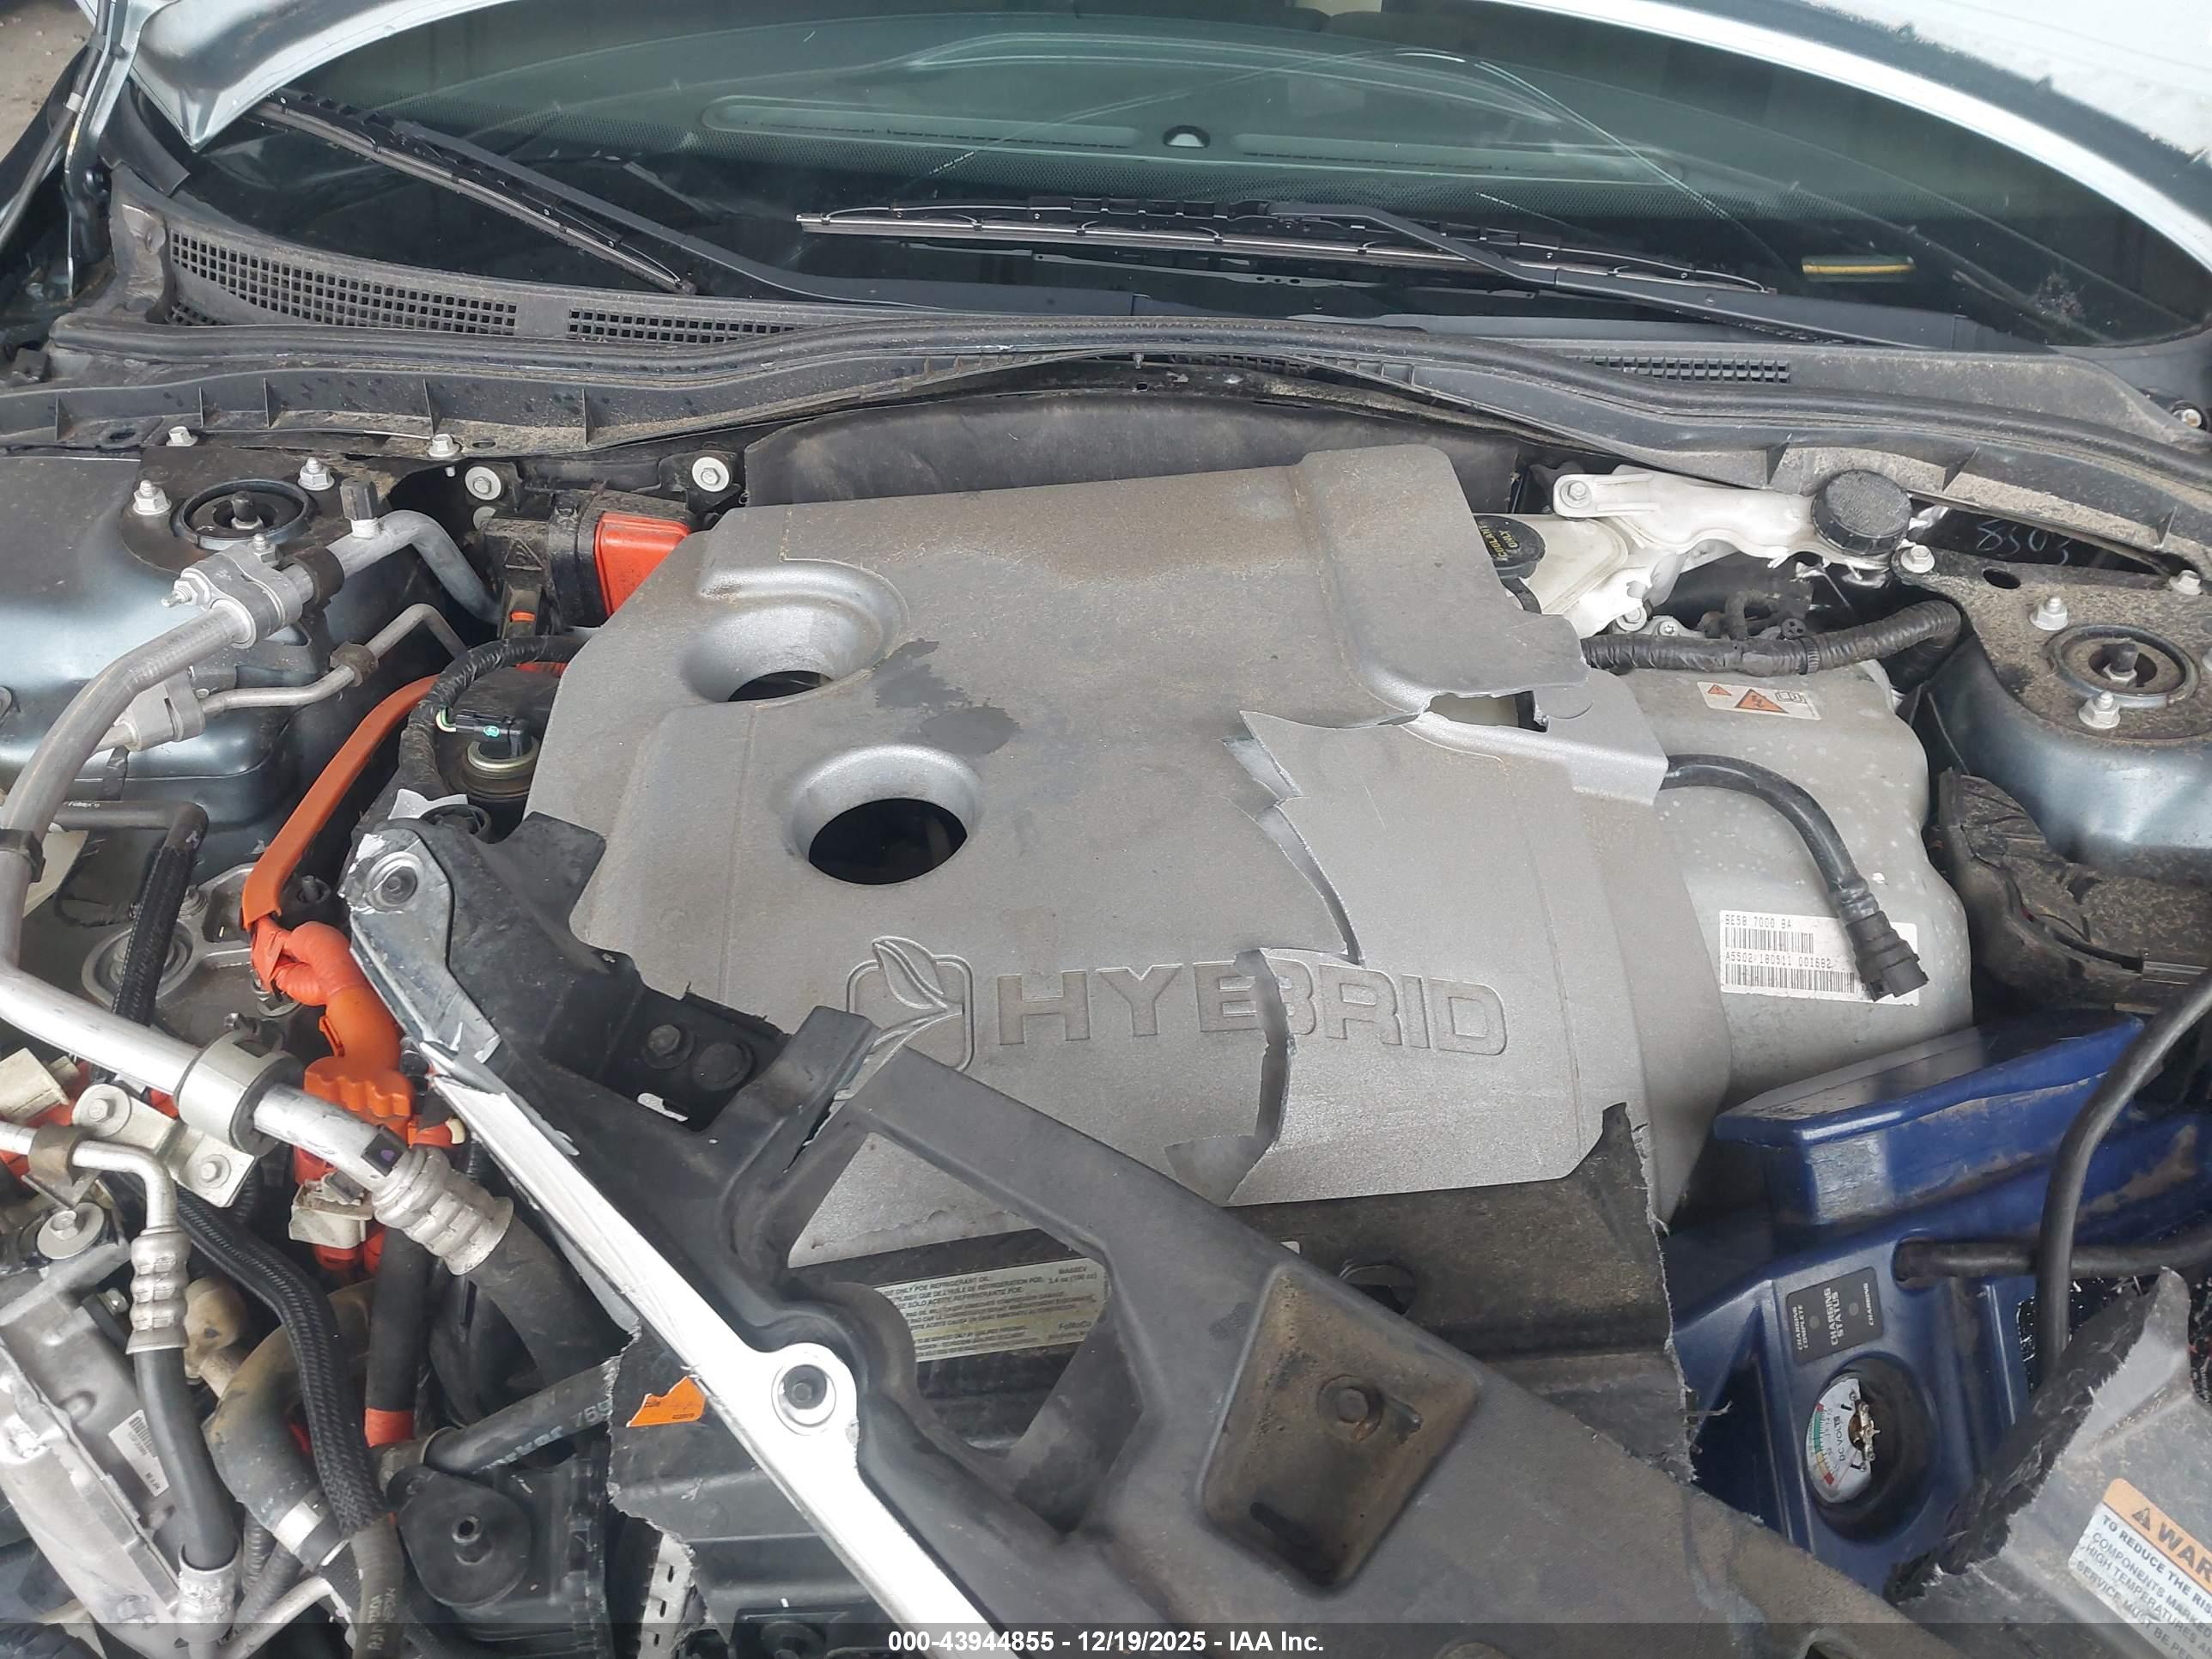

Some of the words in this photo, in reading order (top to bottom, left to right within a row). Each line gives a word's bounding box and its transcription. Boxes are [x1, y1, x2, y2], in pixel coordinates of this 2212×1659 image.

[1798, 1304, 1808, 1348] COMPLETE
[1823, 1287, 1838, 1346] CHARGING
[1832, 1291, 1844, 1337] STATUS
[1863, 1283, 1874, 1325] CHARGING
[1793, 1306, 1803, 1350] CHARGING
[1834, 1416, 1844, 1446] VOLTS
[1838, 1447, 1845, 1462] DC
[2093, 1532, 2165, 1598] COMPONENTS
[2103, 1515, 2118, 1532] TO
[2118, 1531, 2166, 1573] REDUCE
[2166, 1571, 2191, 1595] THE
[2076, 1560, 2121, 1601] SERVICE
[2154, 1627, 2170, 1645] BE
[2086, 1543, 2112, 1571] HIGH
[2114, 1567, 2197, 1644] TEMPERATURES
